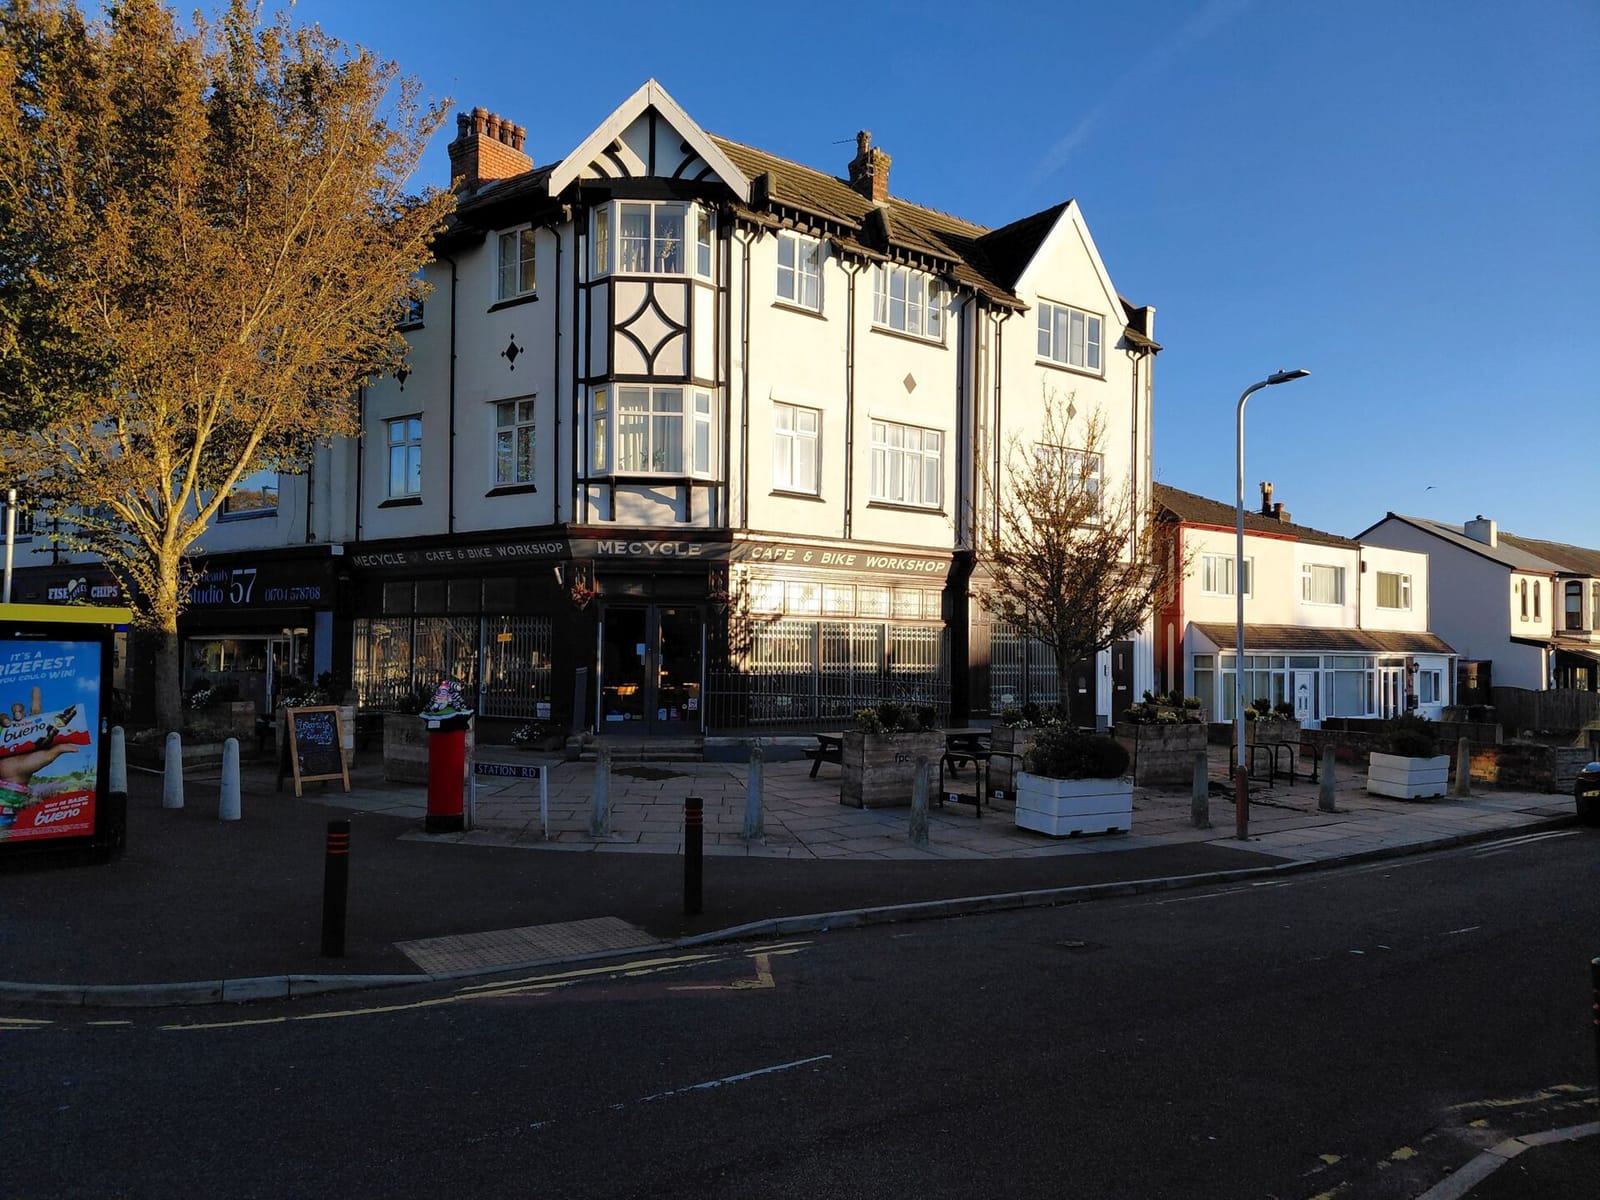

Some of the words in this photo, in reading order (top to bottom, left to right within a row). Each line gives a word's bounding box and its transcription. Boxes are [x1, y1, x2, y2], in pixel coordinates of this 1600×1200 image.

[352, 552, 407, 568] MECYCLE
[425, 550, 454, 562] CAFE
[457, 549, 465, 560] &
[468, 547, 493, 559] BIKE
[496, 542, 564, 557] WORKSHOP
[596, 541, 703, 556] MECYCLE
[751, 546, 796, 561] CAFE
[802, 551, 813, 562] &
[820, 552, 858, 566] BIKE
[866, 556, 946, 573] WORKSHOP
[91, 585, 118, 598] CHIPS
[229, 568, 258, 604] 57
[10, 651, 32, 662] IT'S
[34, 650, 42, 659] A
[18, 672, 46, 682] COULD
[48, 668, 76, 680] WIN!
[3, 722, 46, 743] bueno
[478, 764, 516, 776] STATION
[521, 767, 536, 778] RD
[34, 808, 81, 826] bueno
